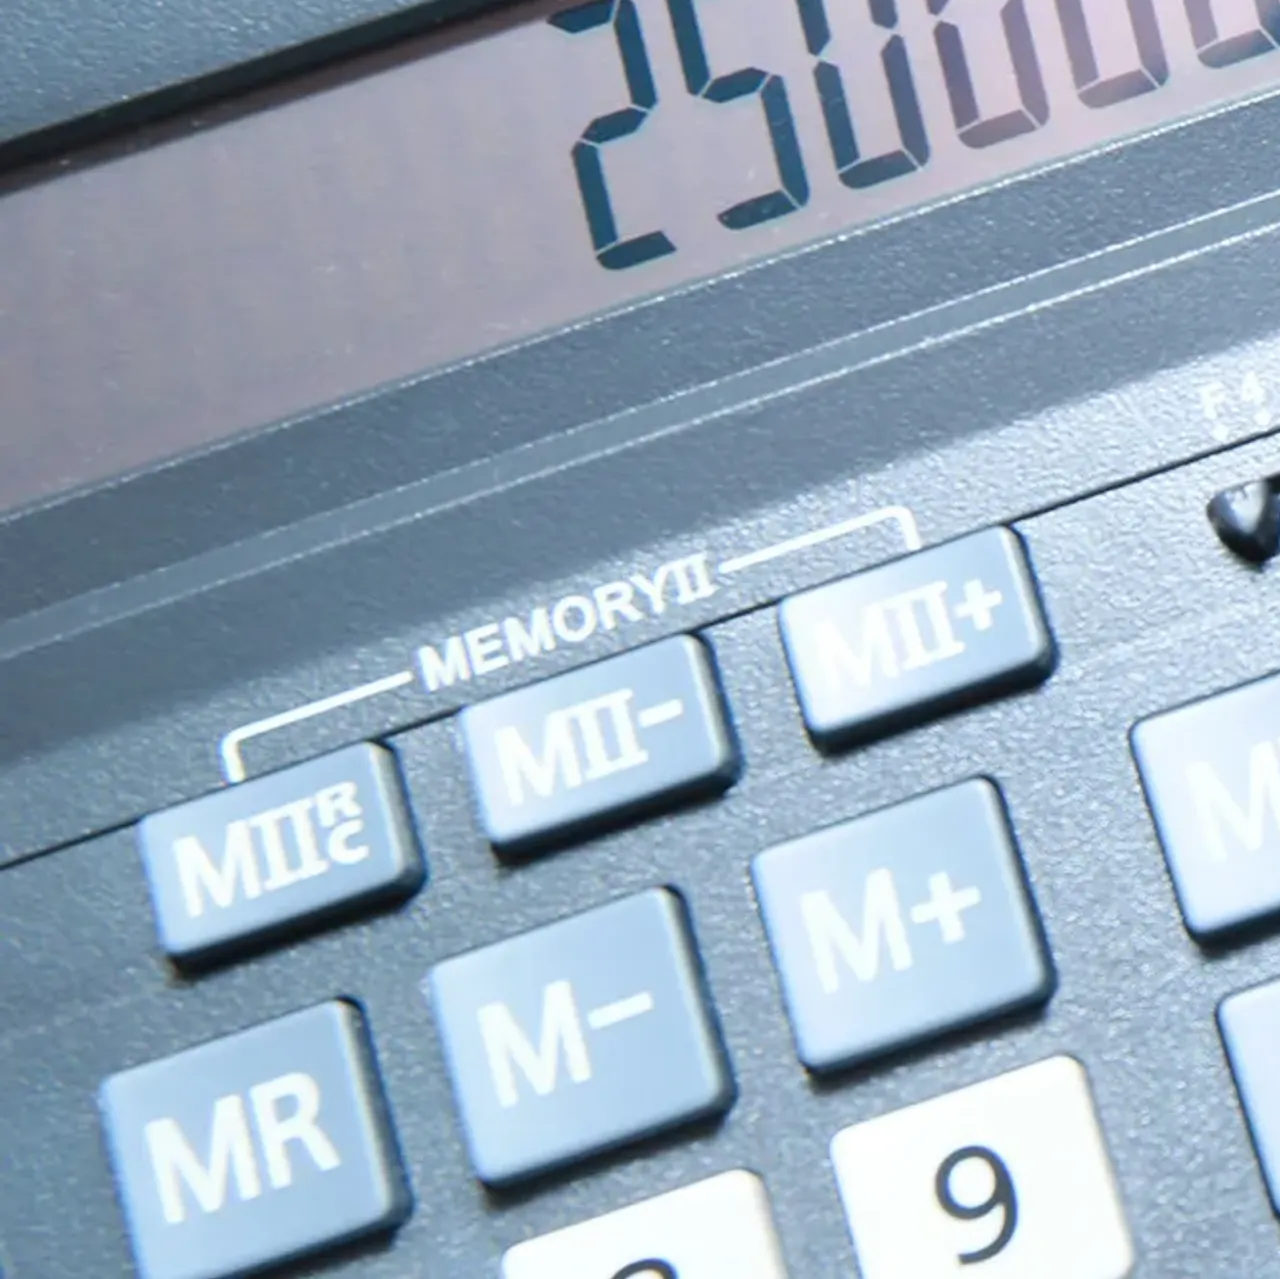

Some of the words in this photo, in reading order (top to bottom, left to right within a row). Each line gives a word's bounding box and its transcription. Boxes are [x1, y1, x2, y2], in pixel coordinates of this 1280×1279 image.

[800, 866, 982, 996] M+
[475, 980, 655, 1109] M-
[142, 1070, 343, 1225] MR
[933, 1144, 1019, 1266] 9
